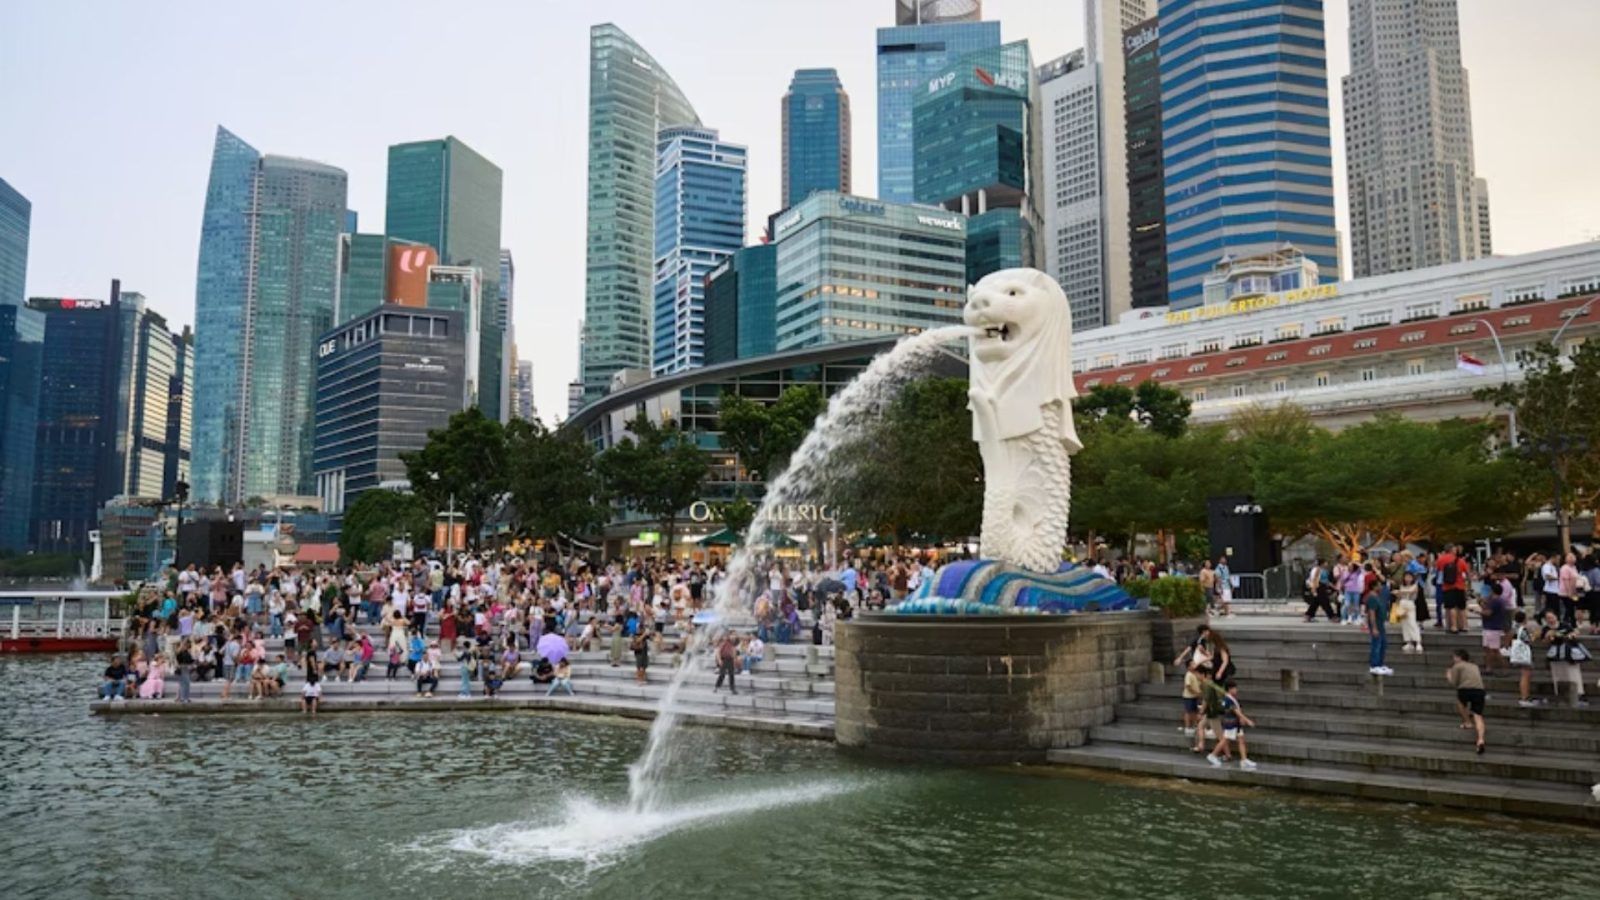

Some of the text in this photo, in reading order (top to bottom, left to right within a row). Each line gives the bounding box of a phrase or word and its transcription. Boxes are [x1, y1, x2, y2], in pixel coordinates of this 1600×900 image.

[927, 72, 957, 94] MYP
[917, 215, 962, 231] wework
[1165, 284, 1338, 325] THE FULLERTON HOTEL
